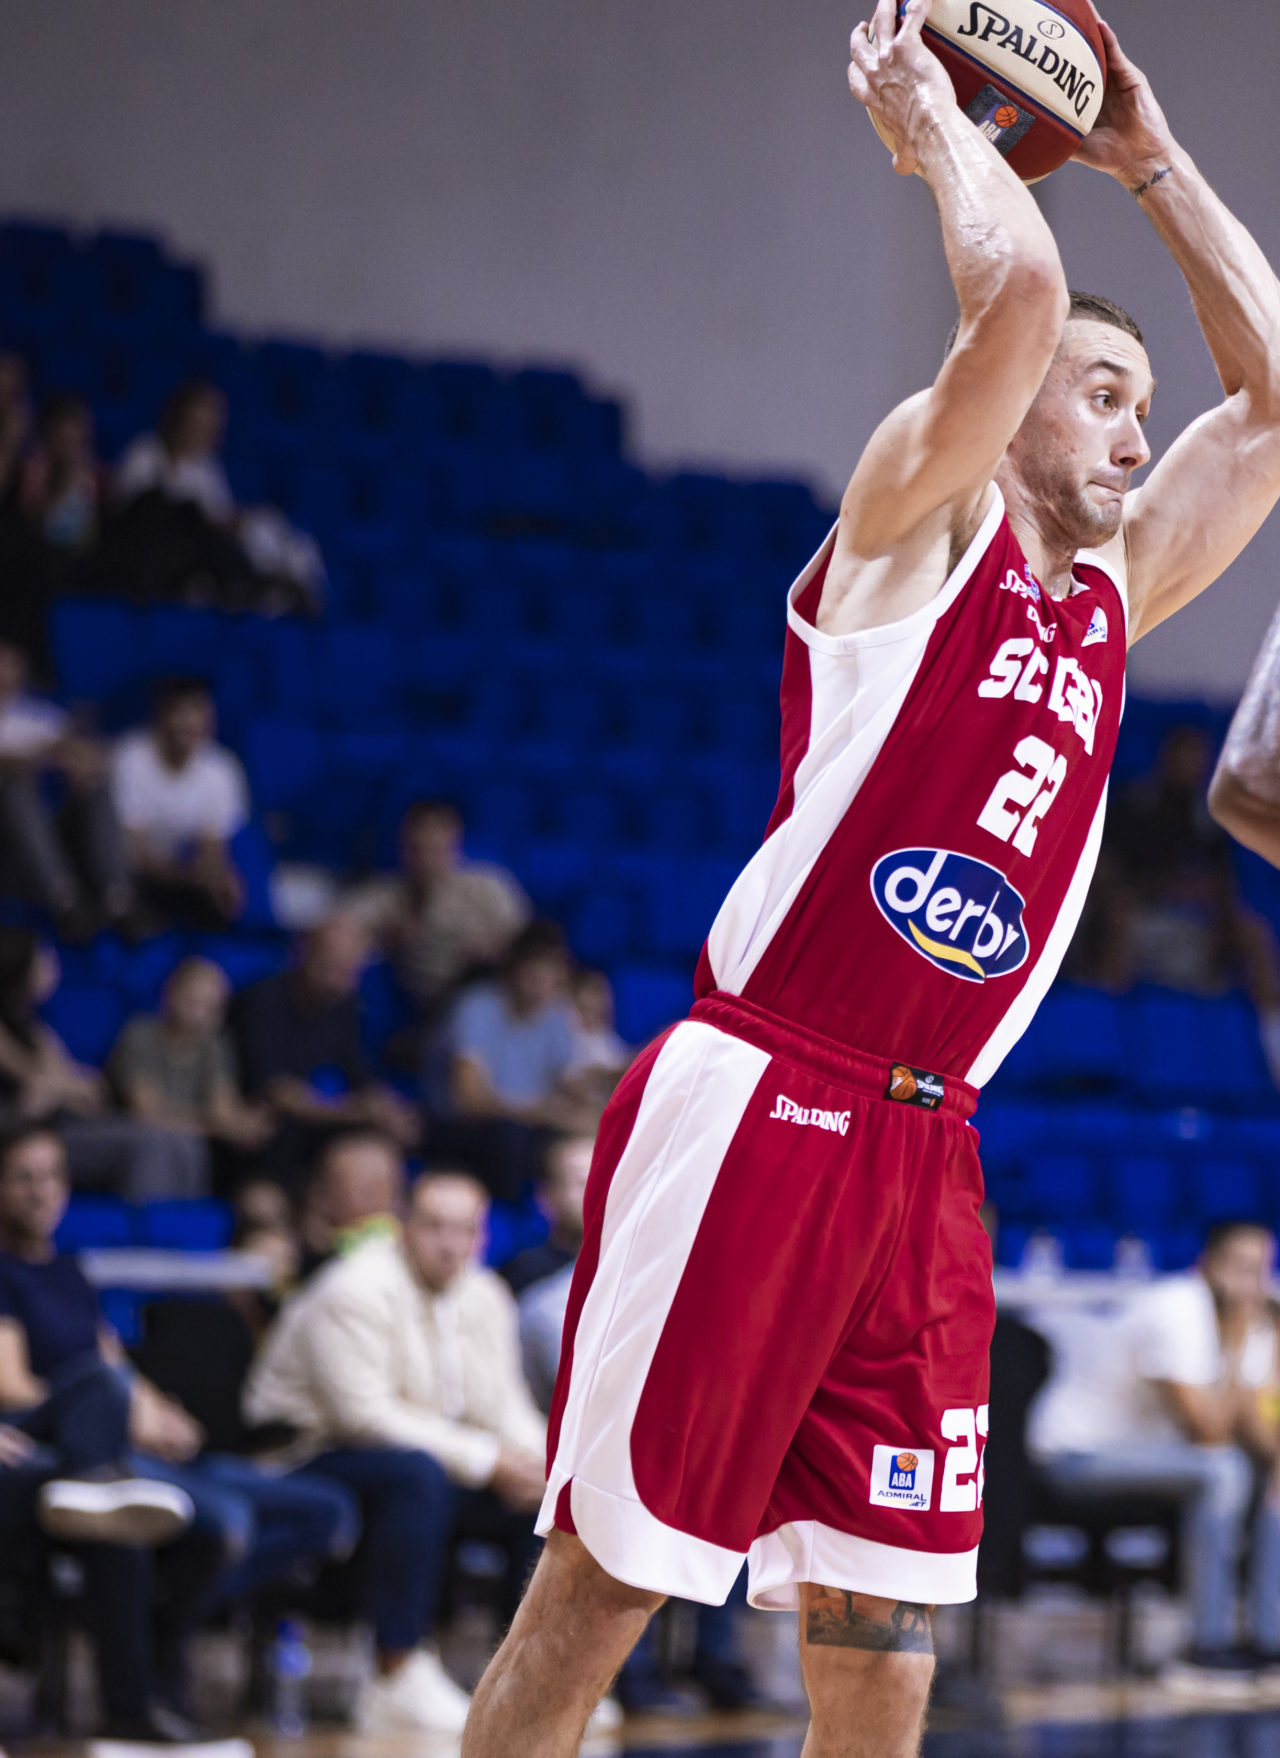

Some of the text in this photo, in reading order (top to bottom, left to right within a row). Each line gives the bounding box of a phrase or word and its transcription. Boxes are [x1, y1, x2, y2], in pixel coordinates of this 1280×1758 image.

[957, 2, 1095, 118] SPALDING
[976, 735, 1068, 858] 22
[884, 851, 1020, 960] derby
[769, 1094, 851, 1136] SPALDING
[877, 1490, 927, 1502] ADMIRAL
[891, 1472, 913, 1488] ABA
